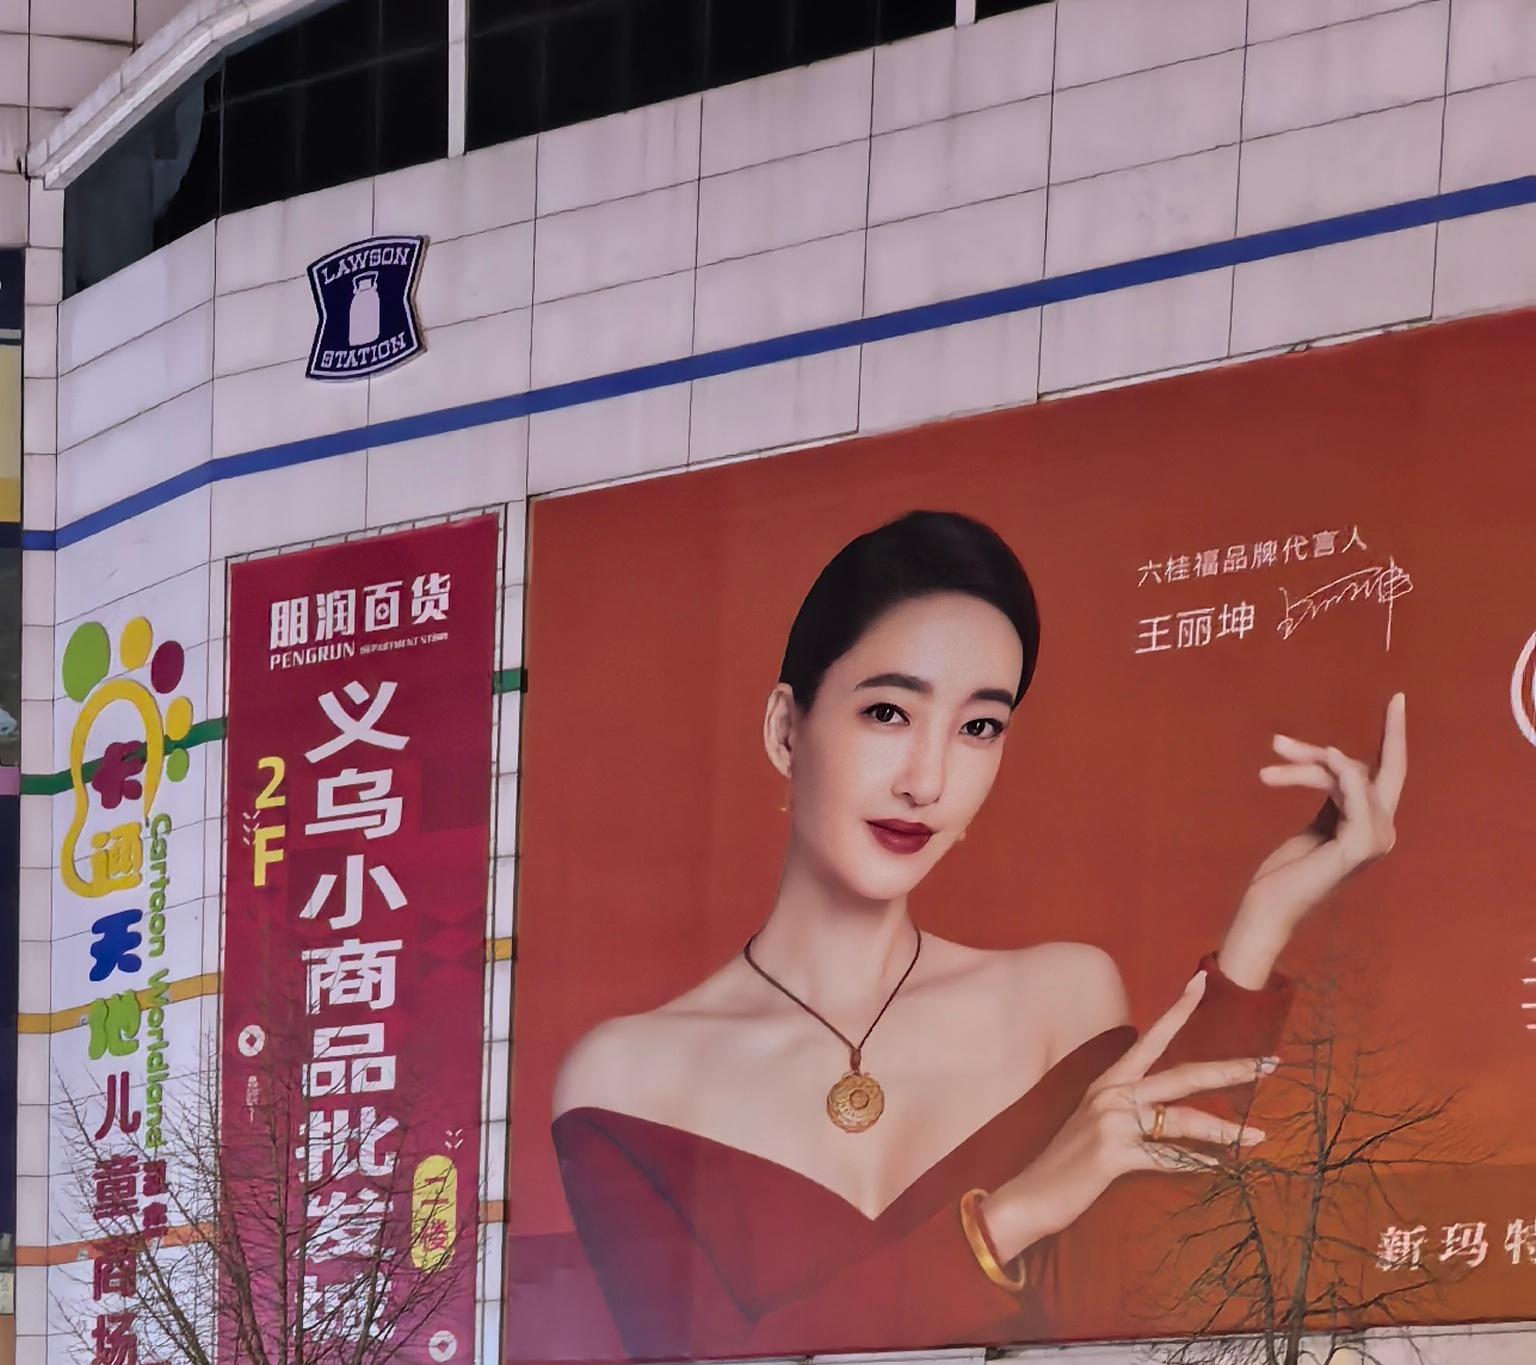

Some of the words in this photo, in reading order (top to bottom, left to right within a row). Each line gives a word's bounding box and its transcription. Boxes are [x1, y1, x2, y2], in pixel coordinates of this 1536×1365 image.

[321, 247, 411, 285] LAWSON
[320, 331, 407, 369] STATION
[1136, 525, 1369, 588] 六桂福品牌代言人
[269, 572, 452, 650] 朋润百货
[1134, 600, 1257, 655] 王丽坤
[269, 641, 356, 671] PENGRUN
[252, 755, 287, 887] 2F
[146, 812, 173, 959] Cartoon
[292, 679, 411, 1346] 义乌小商品批发城
[144, 967, 171, 1150] Worldland
